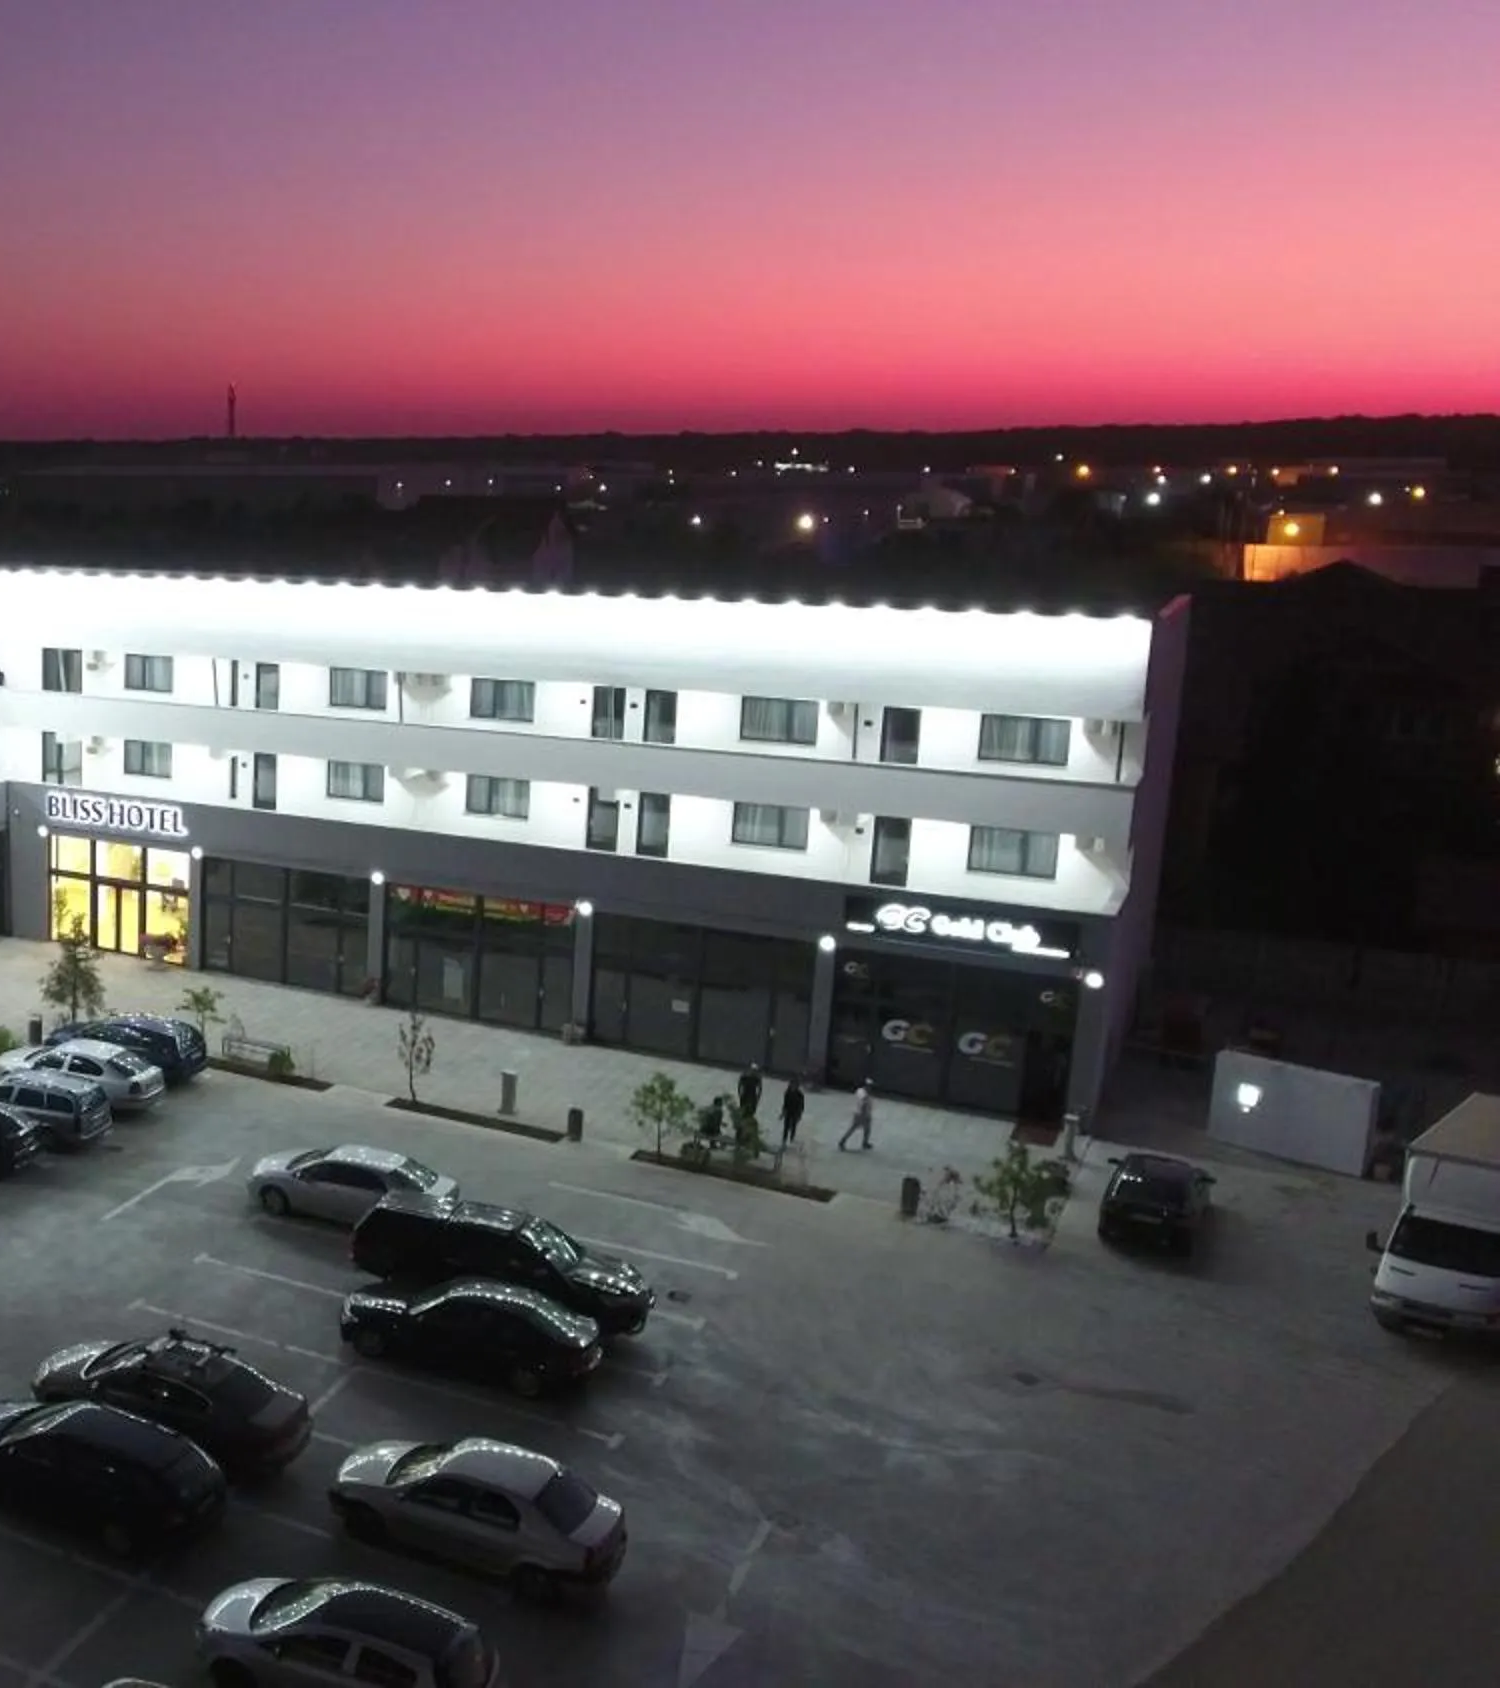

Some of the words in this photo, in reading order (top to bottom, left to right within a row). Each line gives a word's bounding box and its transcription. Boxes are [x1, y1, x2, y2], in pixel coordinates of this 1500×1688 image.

[47, 794, 103, 824] BLISS
[108, 801, 184, 834] HOTEL
[881, 1019, 933, 1045] GC
[958, 1032, 1012, 1057] GC
